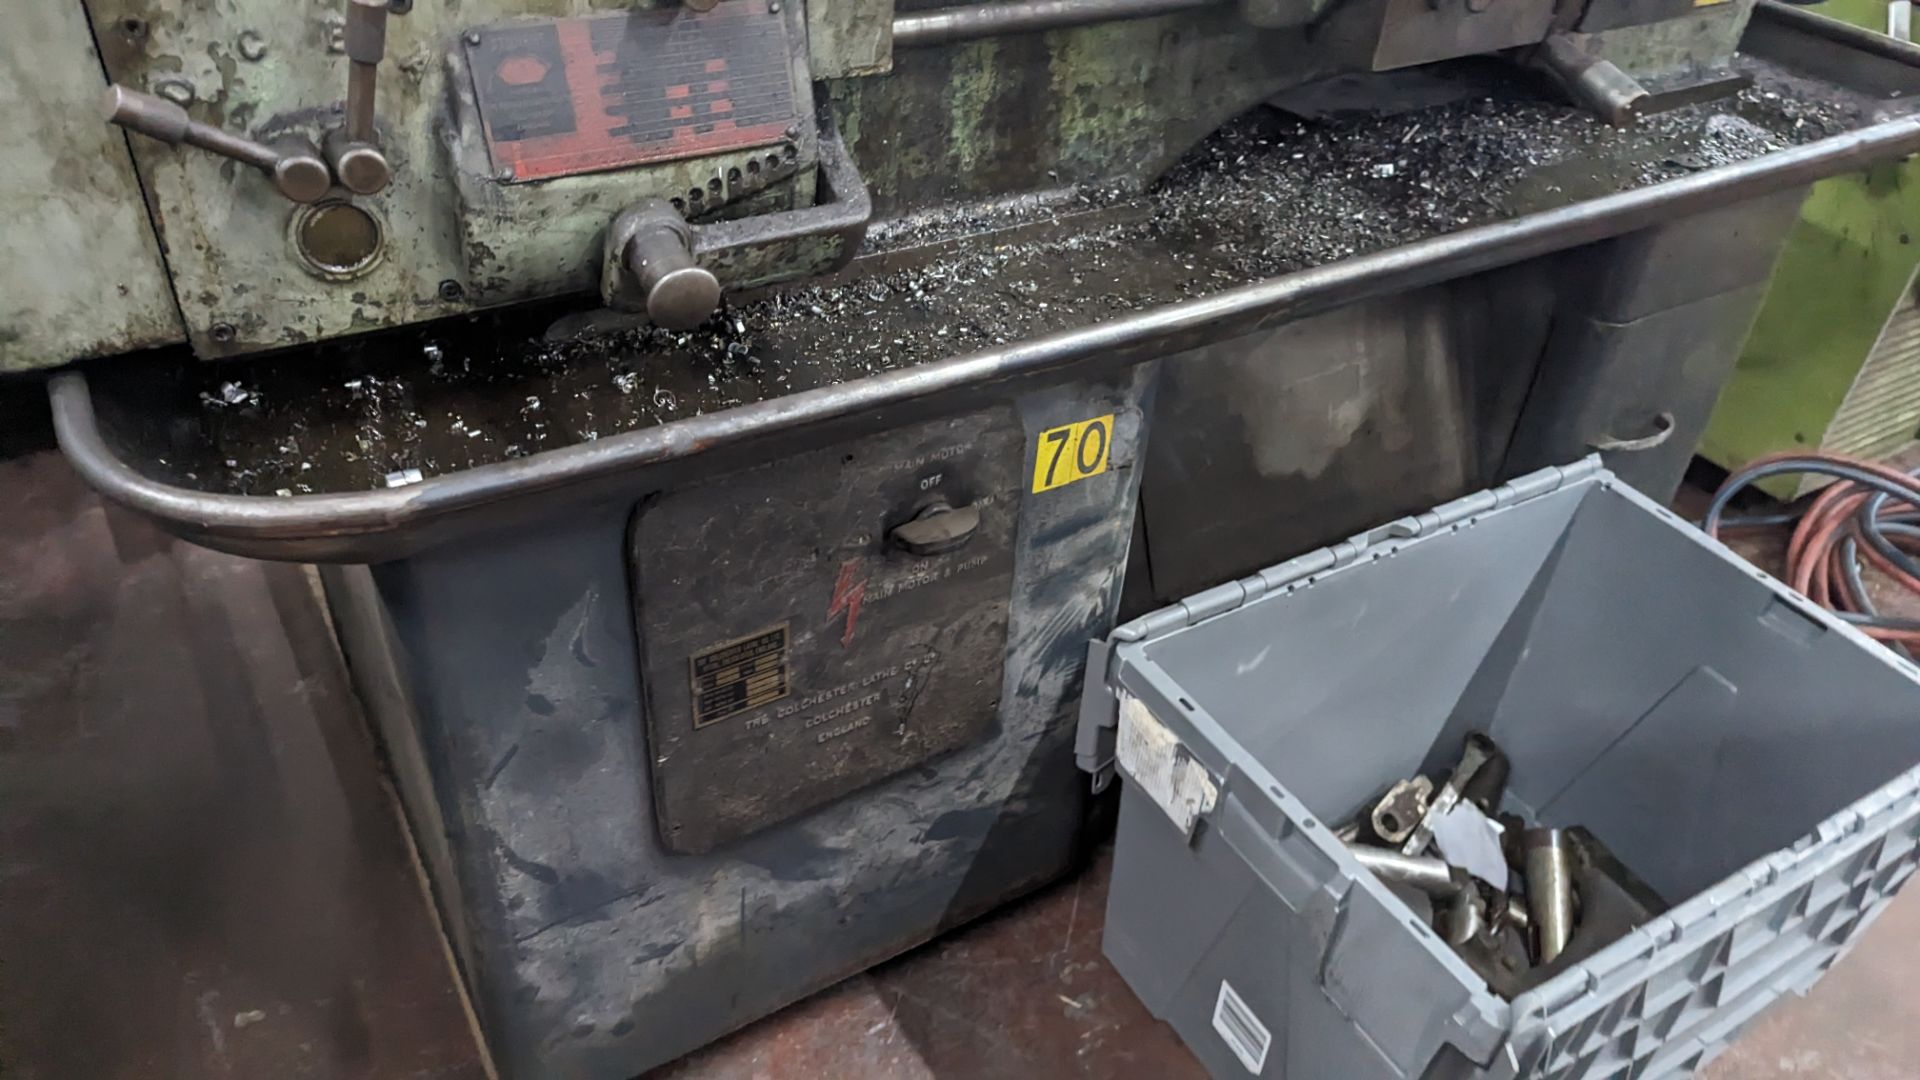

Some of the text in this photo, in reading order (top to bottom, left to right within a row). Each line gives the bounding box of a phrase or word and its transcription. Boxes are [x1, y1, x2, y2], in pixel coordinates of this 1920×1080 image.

[1045, 421, 1106, 487] 70
[920, 473, 942, 490] OFF
[912, 560, 929, 574] ON
[899, 571, 938, 592] MOTOR
[745, 713, 769, 730] THE
[862, 665, 898, 687] LATHE
[805, 692, 880, 728] COLCHESTER
[818, 716, 871, 742] ENGLAND
